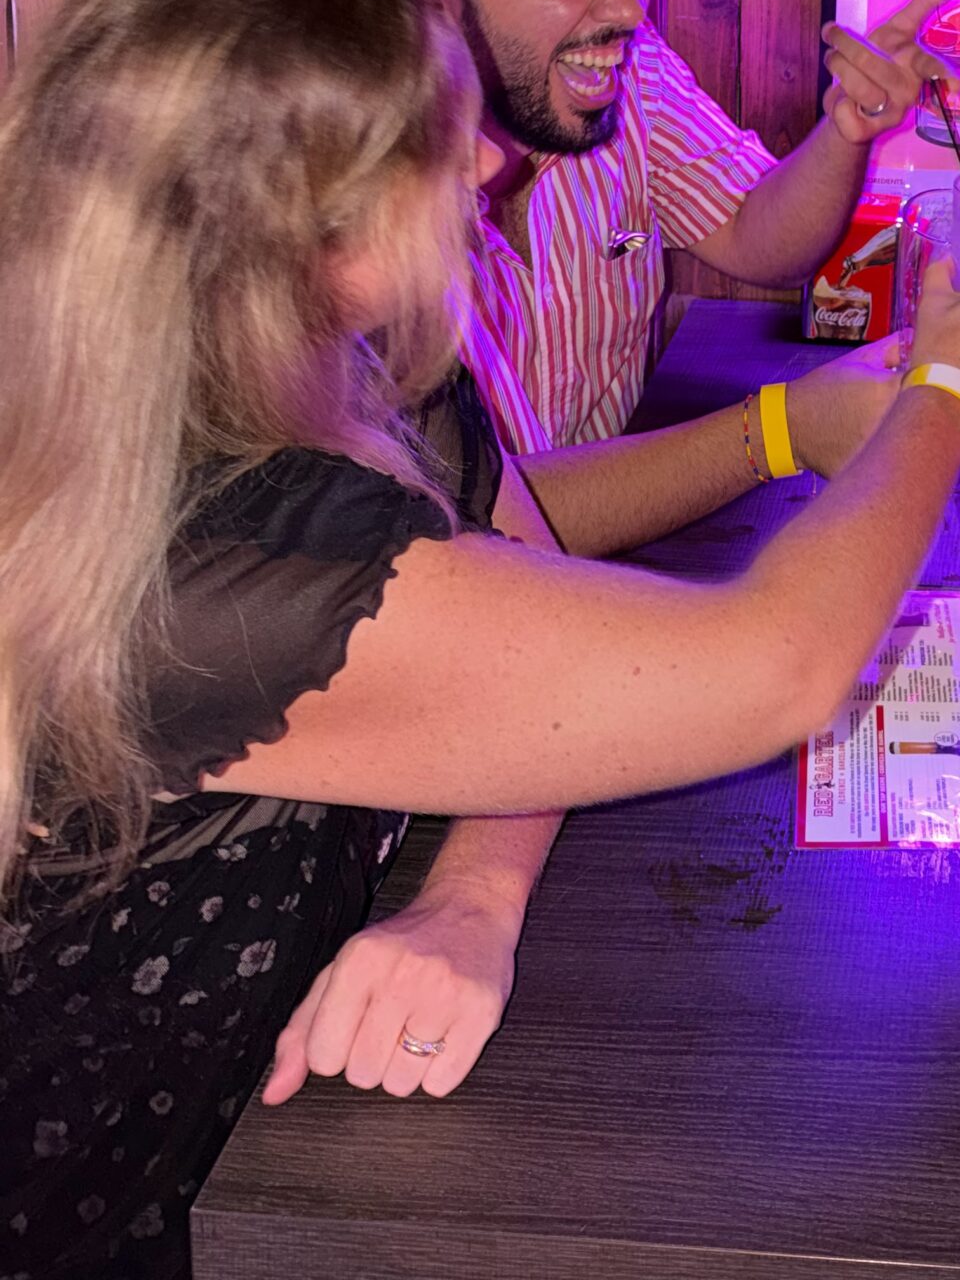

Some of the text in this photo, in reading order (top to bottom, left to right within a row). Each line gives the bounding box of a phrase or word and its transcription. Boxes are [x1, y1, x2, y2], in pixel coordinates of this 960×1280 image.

[814, 306, 867, 328] Coca-Cola
[813, 730, 834, 817] RED GARTER
[838, 741, 846, 805] FLORENCE BARCELONA
